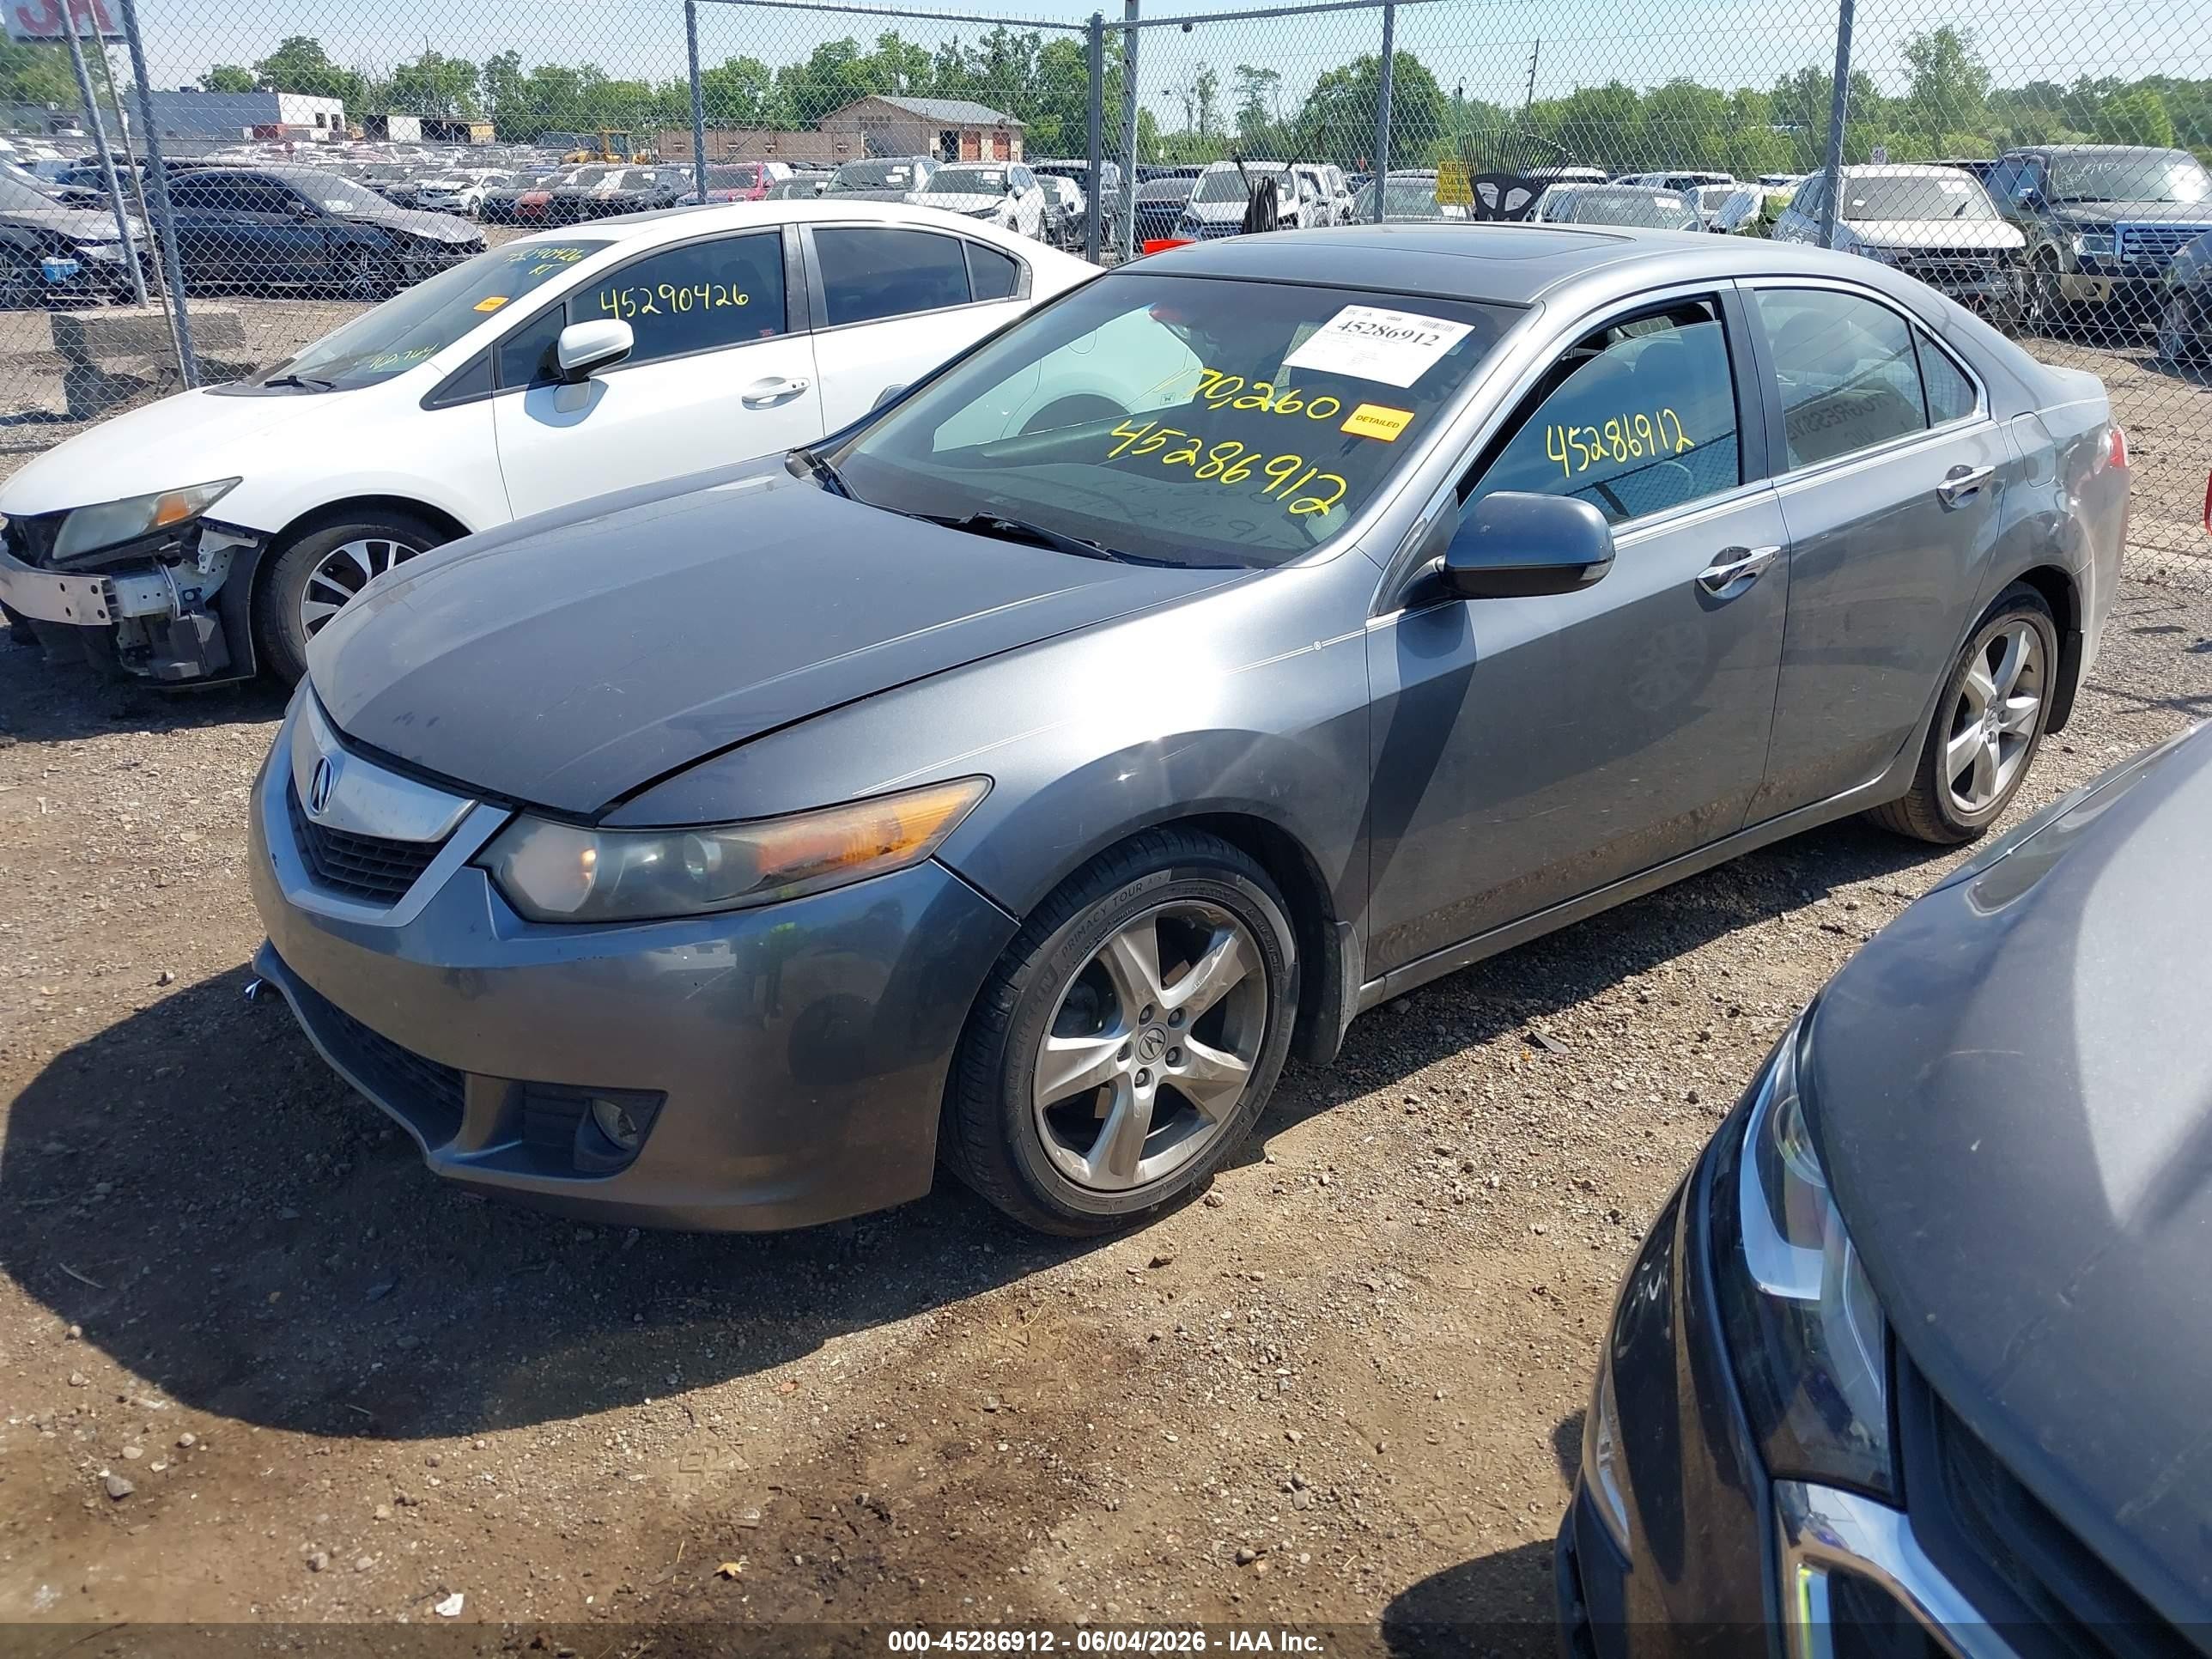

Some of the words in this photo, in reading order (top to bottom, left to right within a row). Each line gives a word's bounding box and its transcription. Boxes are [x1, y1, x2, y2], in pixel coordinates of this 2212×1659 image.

[600, 283, 750, 320] 45290426
[1337, 319, 1441, 347] 45286912
[1356, 414, 1401, 429] DETAILED
[1547, 407, 1697, 479] 45286912
[1107, 419, 1347, 516] 45286912
[1061, 904, 1109, 958] PRIMACY
[1113, 882, 1143, 907] TOUR
